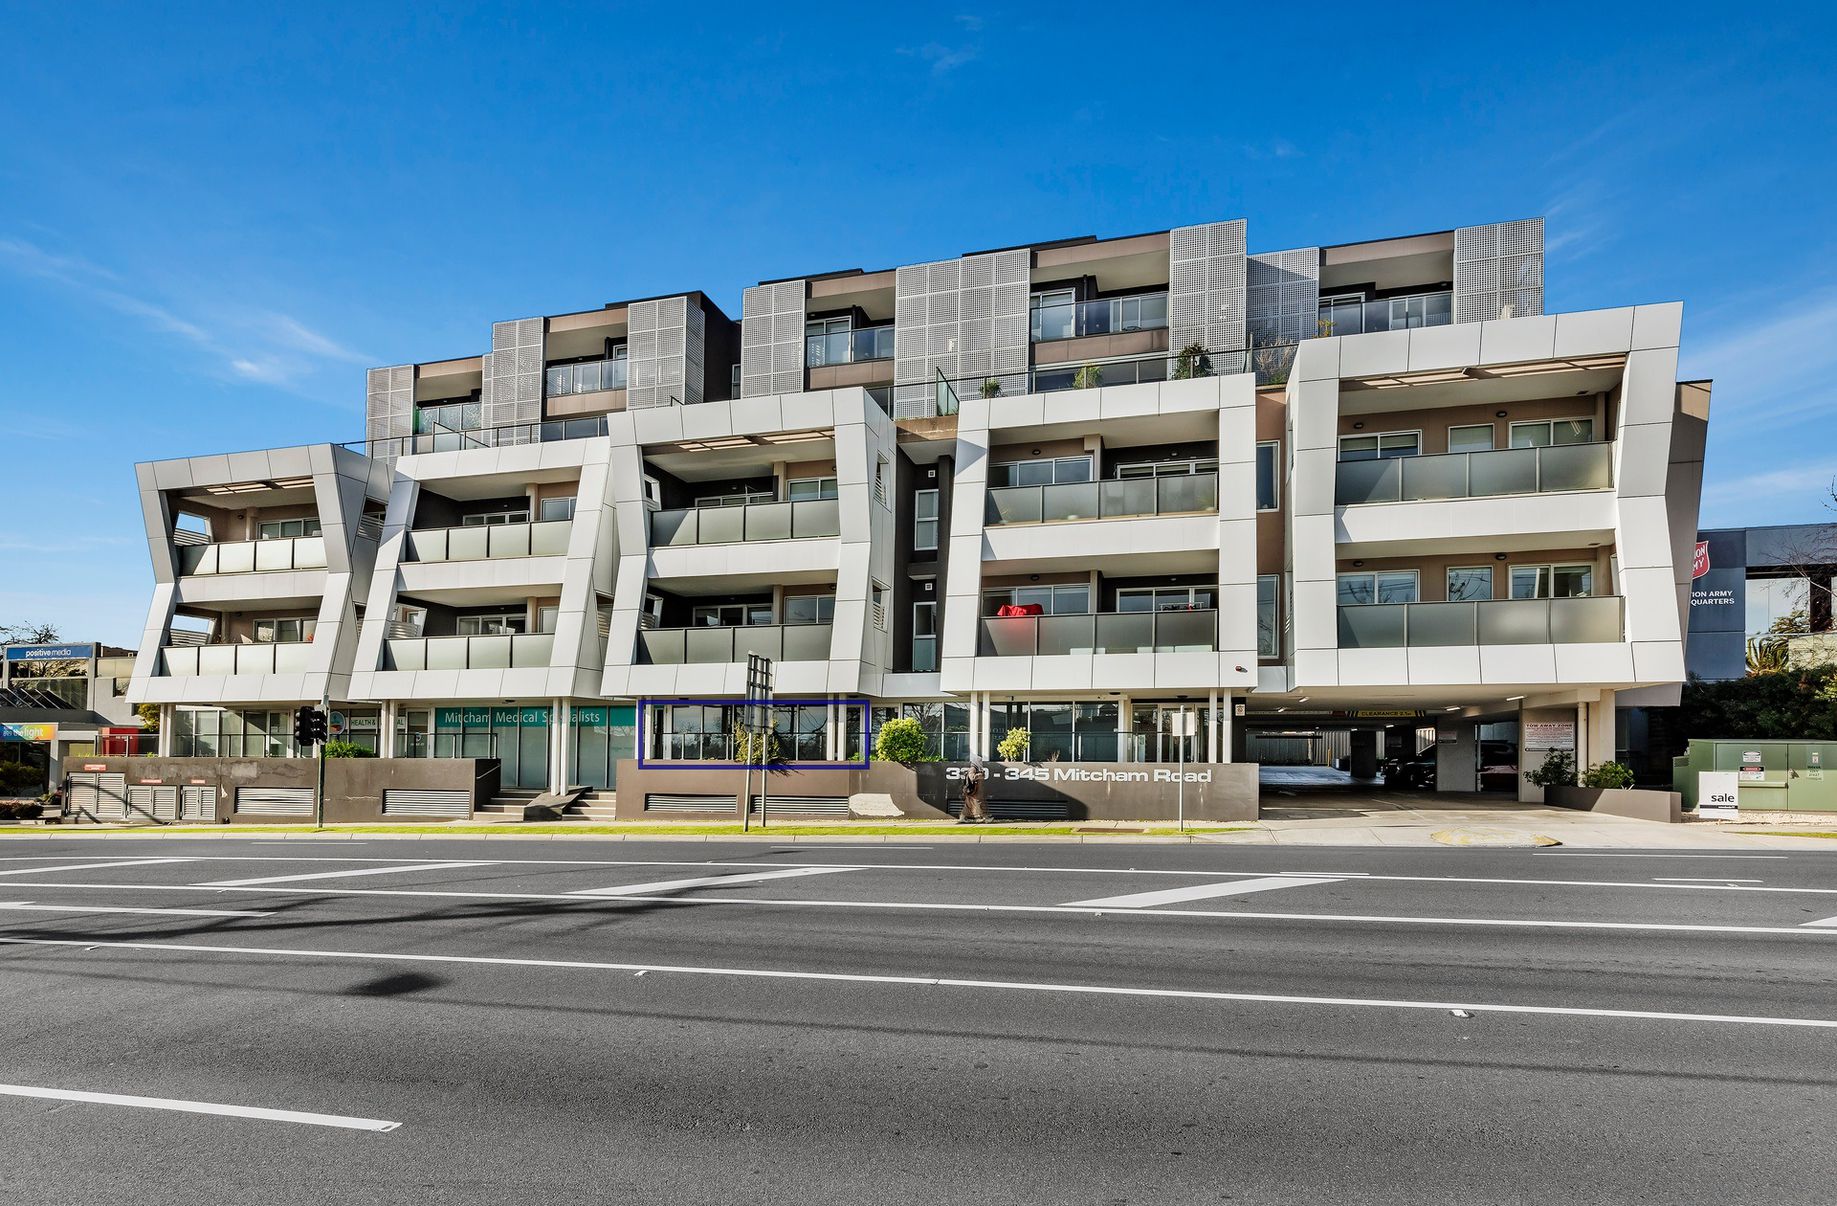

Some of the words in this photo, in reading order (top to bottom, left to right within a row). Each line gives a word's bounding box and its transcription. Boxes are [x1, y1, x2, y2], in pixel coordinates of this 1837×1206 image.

[1690, 598, 1735, 606] QUARTERS
[25, 649, 51, 658] positive
[51, 648, 72, 656] media
[444, 712, 490, 723] Mitcham
[495, 711, 538, 723] Medical
[541, 710, 600, 725] Spialists
[24, 728, 44, 738] light
[1004, 768, 1050, 780] 345
[1053, 768, 1149, 782] Mitcham
[1153, 769, 1212, 782] Road
[1710, 793, 1735, 802] sale
